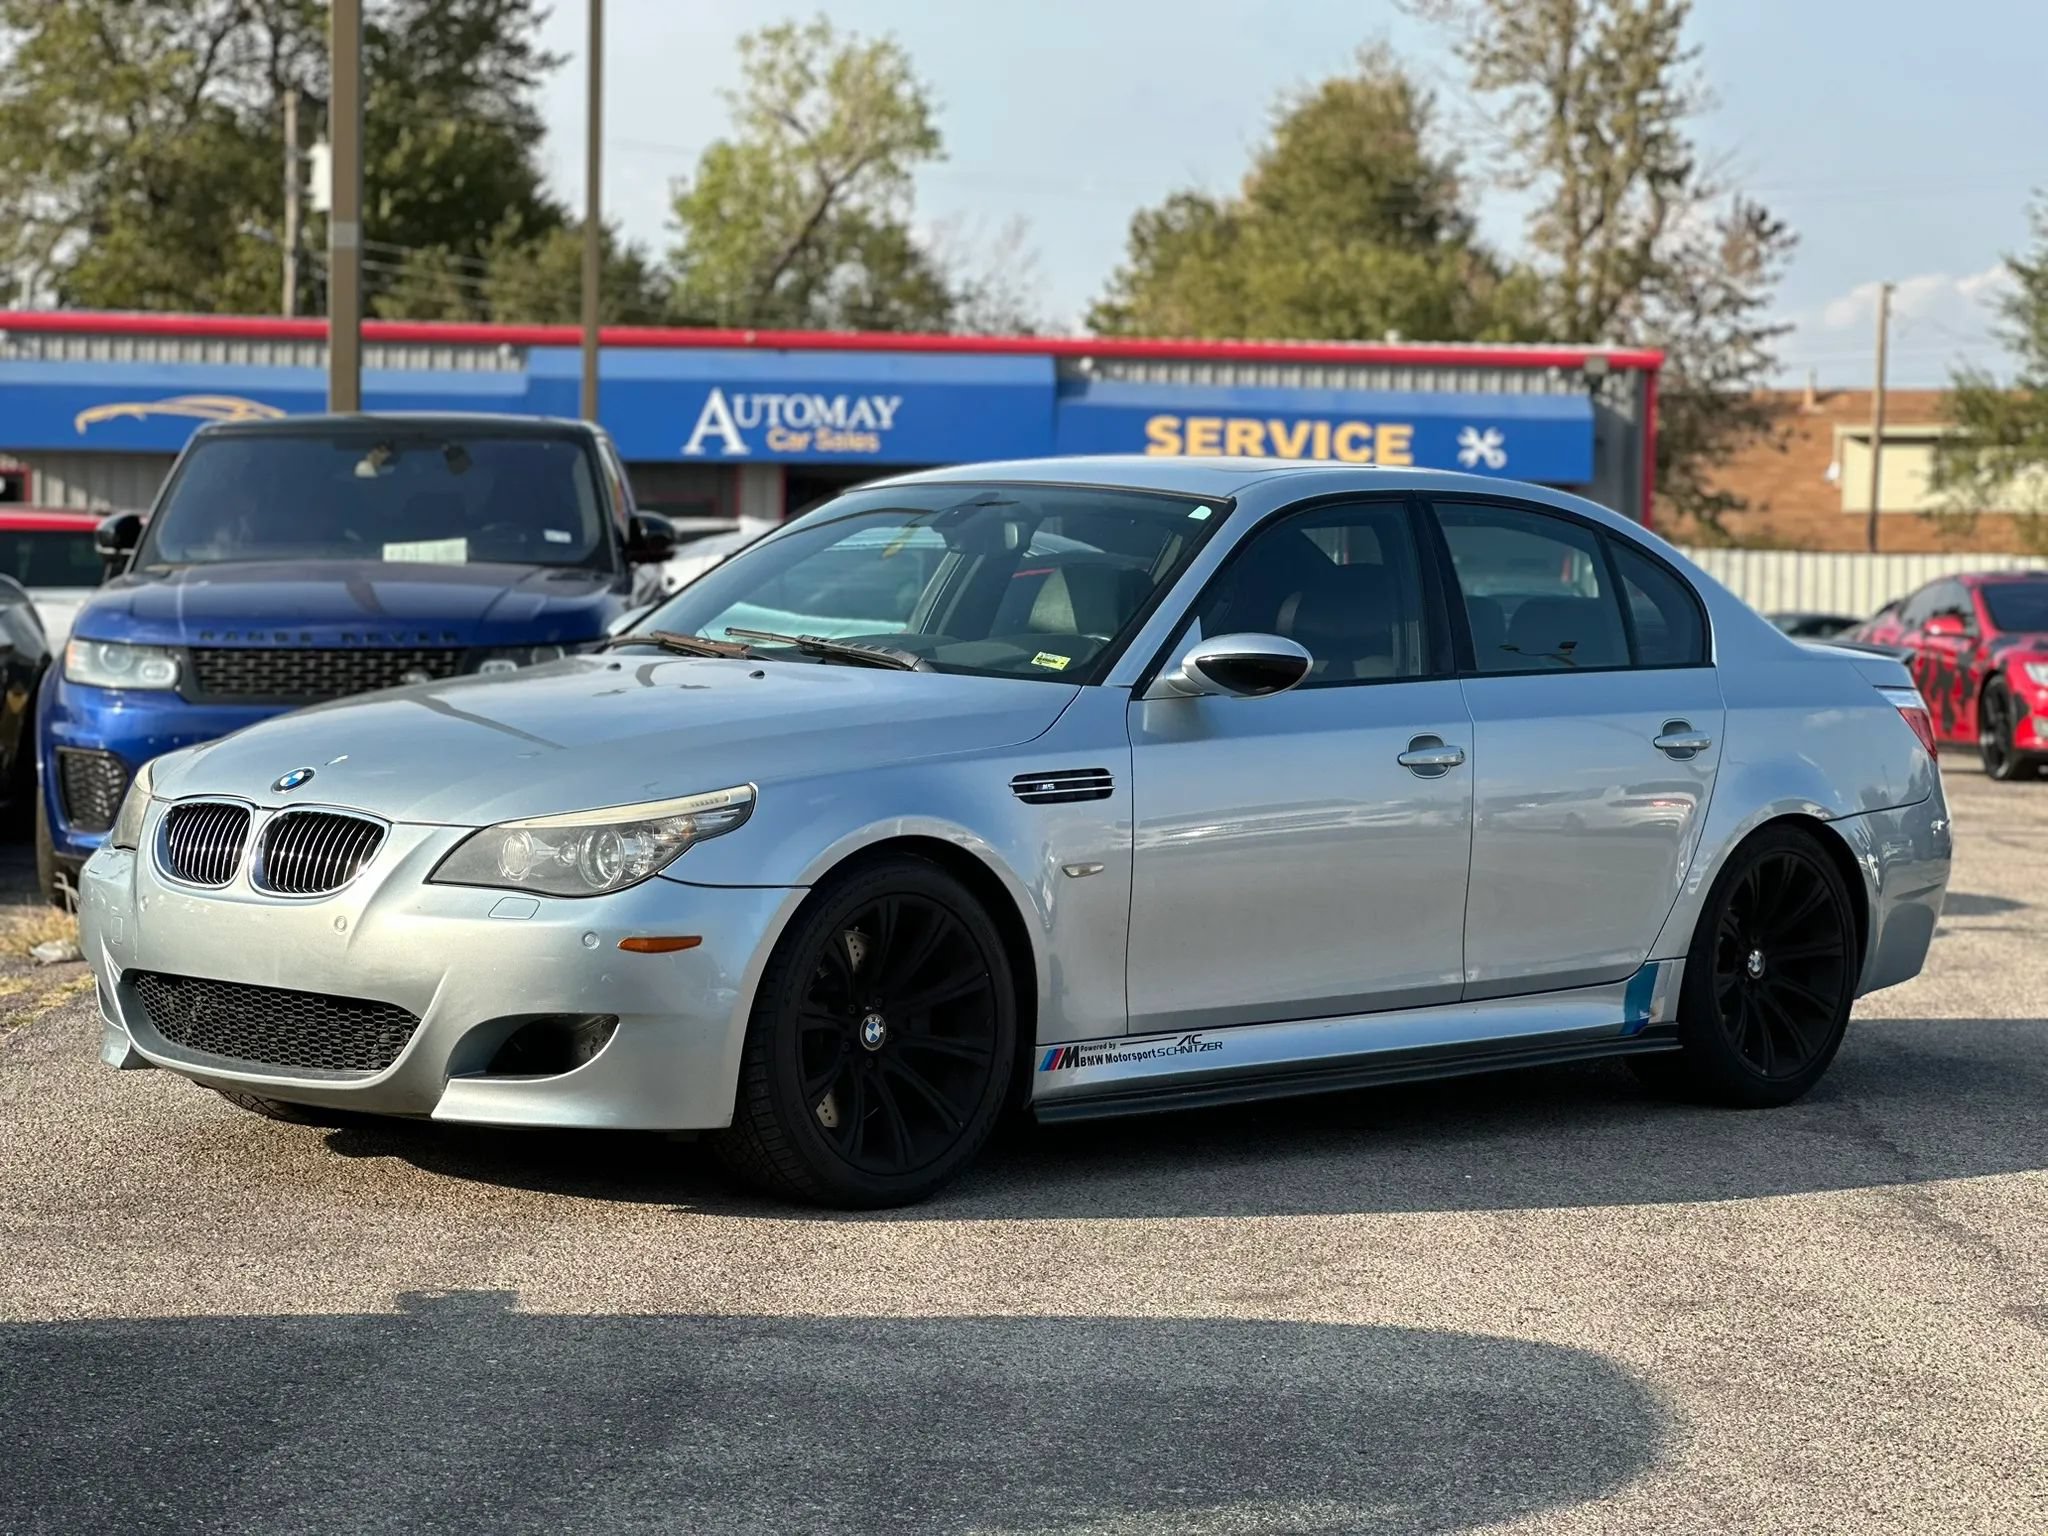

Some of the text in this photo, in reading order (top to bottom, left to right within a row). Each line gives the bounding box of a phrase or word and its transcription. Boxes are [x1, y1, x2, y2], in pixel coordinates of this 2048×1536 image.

[681, 386, 902, 456] AUTOMAY
[766, 426, 881, 453] Car Sales
[1145, 415, 1414, 466] SERVICE
[199, 630, 459, 644] RANGE ROVER
[1080, 1041, 1117, 1053] Powered by
[1177, 1033, 1203, 1046] AC
[1080, 1048, 1157, 1067] BMW Motorsport
[1156, 1041, 1224, 1058] SCHNITZER
